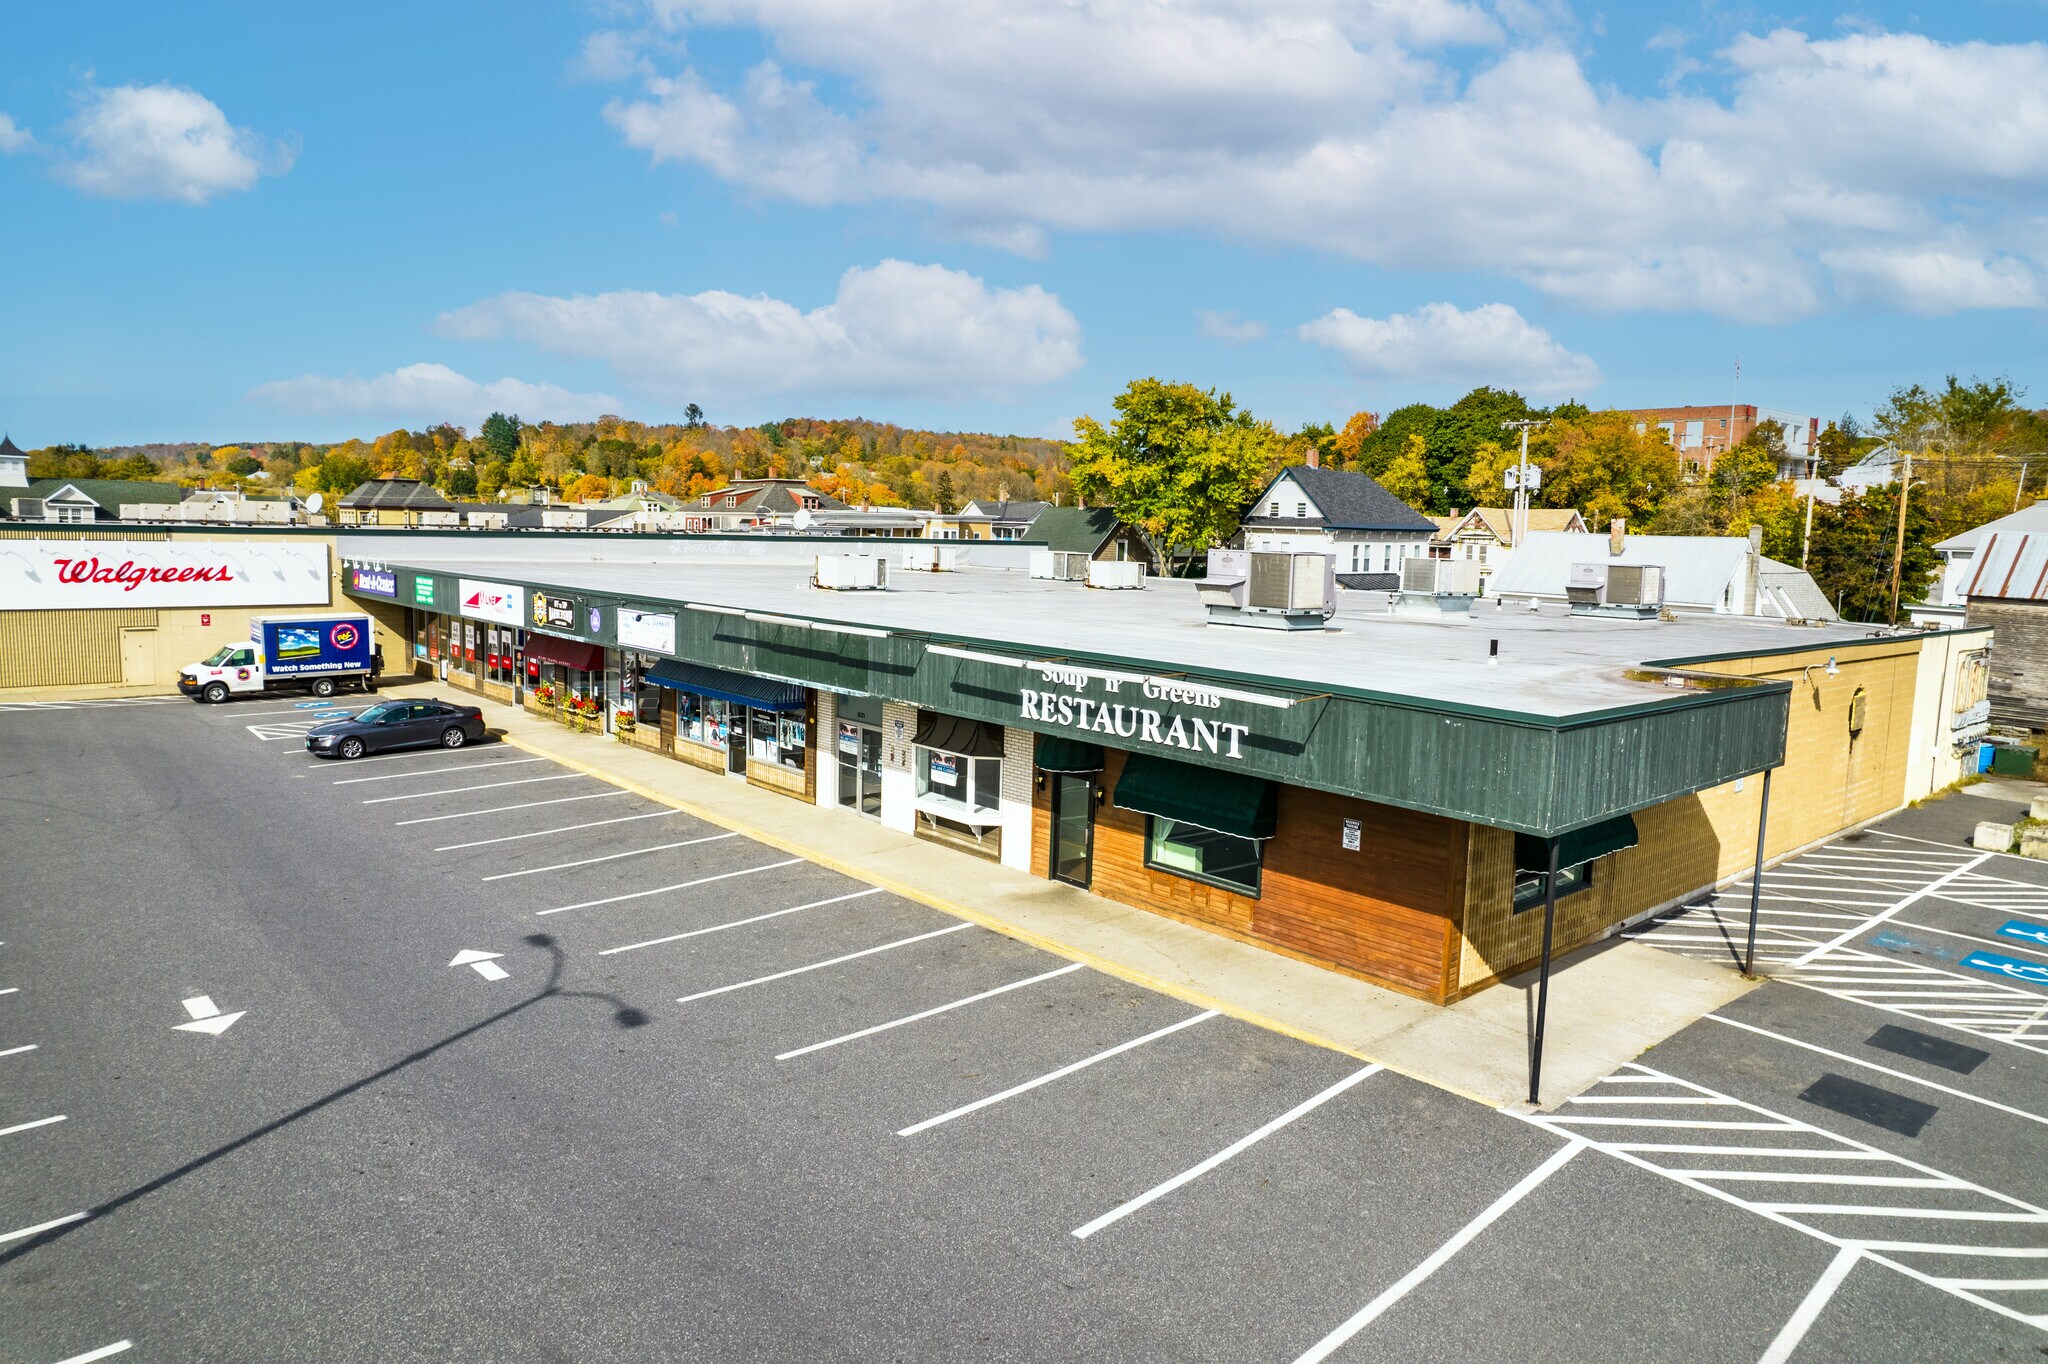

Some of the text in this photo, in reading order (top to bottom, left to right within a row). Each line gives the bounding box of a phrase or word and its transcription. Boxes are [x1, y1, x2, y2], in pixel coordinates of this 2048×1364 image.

[53, 557, 234, 592] Walgreens
[299, 662, 343, 671] Something
[1041, 664, 1088, 693] Soup
[1143, 677, 1221, 709] Greens
[1019, 688, 1249, 760] RESTAURANT
